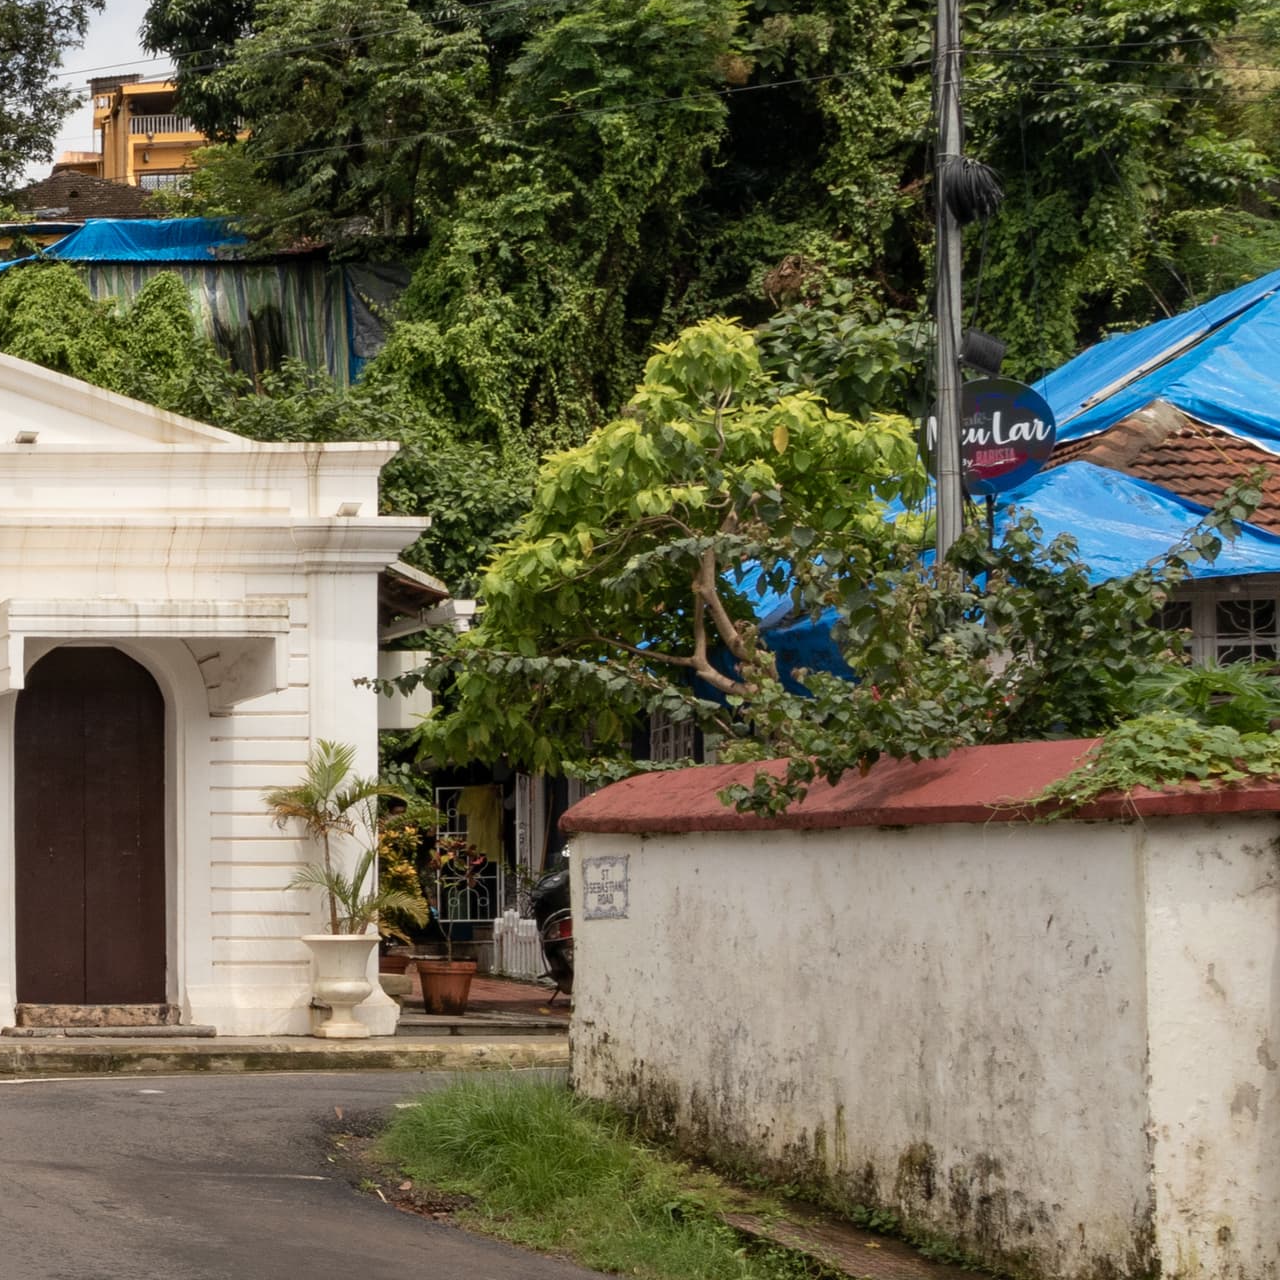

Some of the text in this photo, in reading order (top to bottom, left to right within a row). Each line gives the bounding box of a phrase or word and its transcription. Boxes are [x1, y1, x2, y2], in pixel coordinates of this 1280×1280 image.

[992, 411, 1052, 445] Lar
[975, 447, 1016, 465] BARISTA
[597, 893, 614, 905] ROAD
